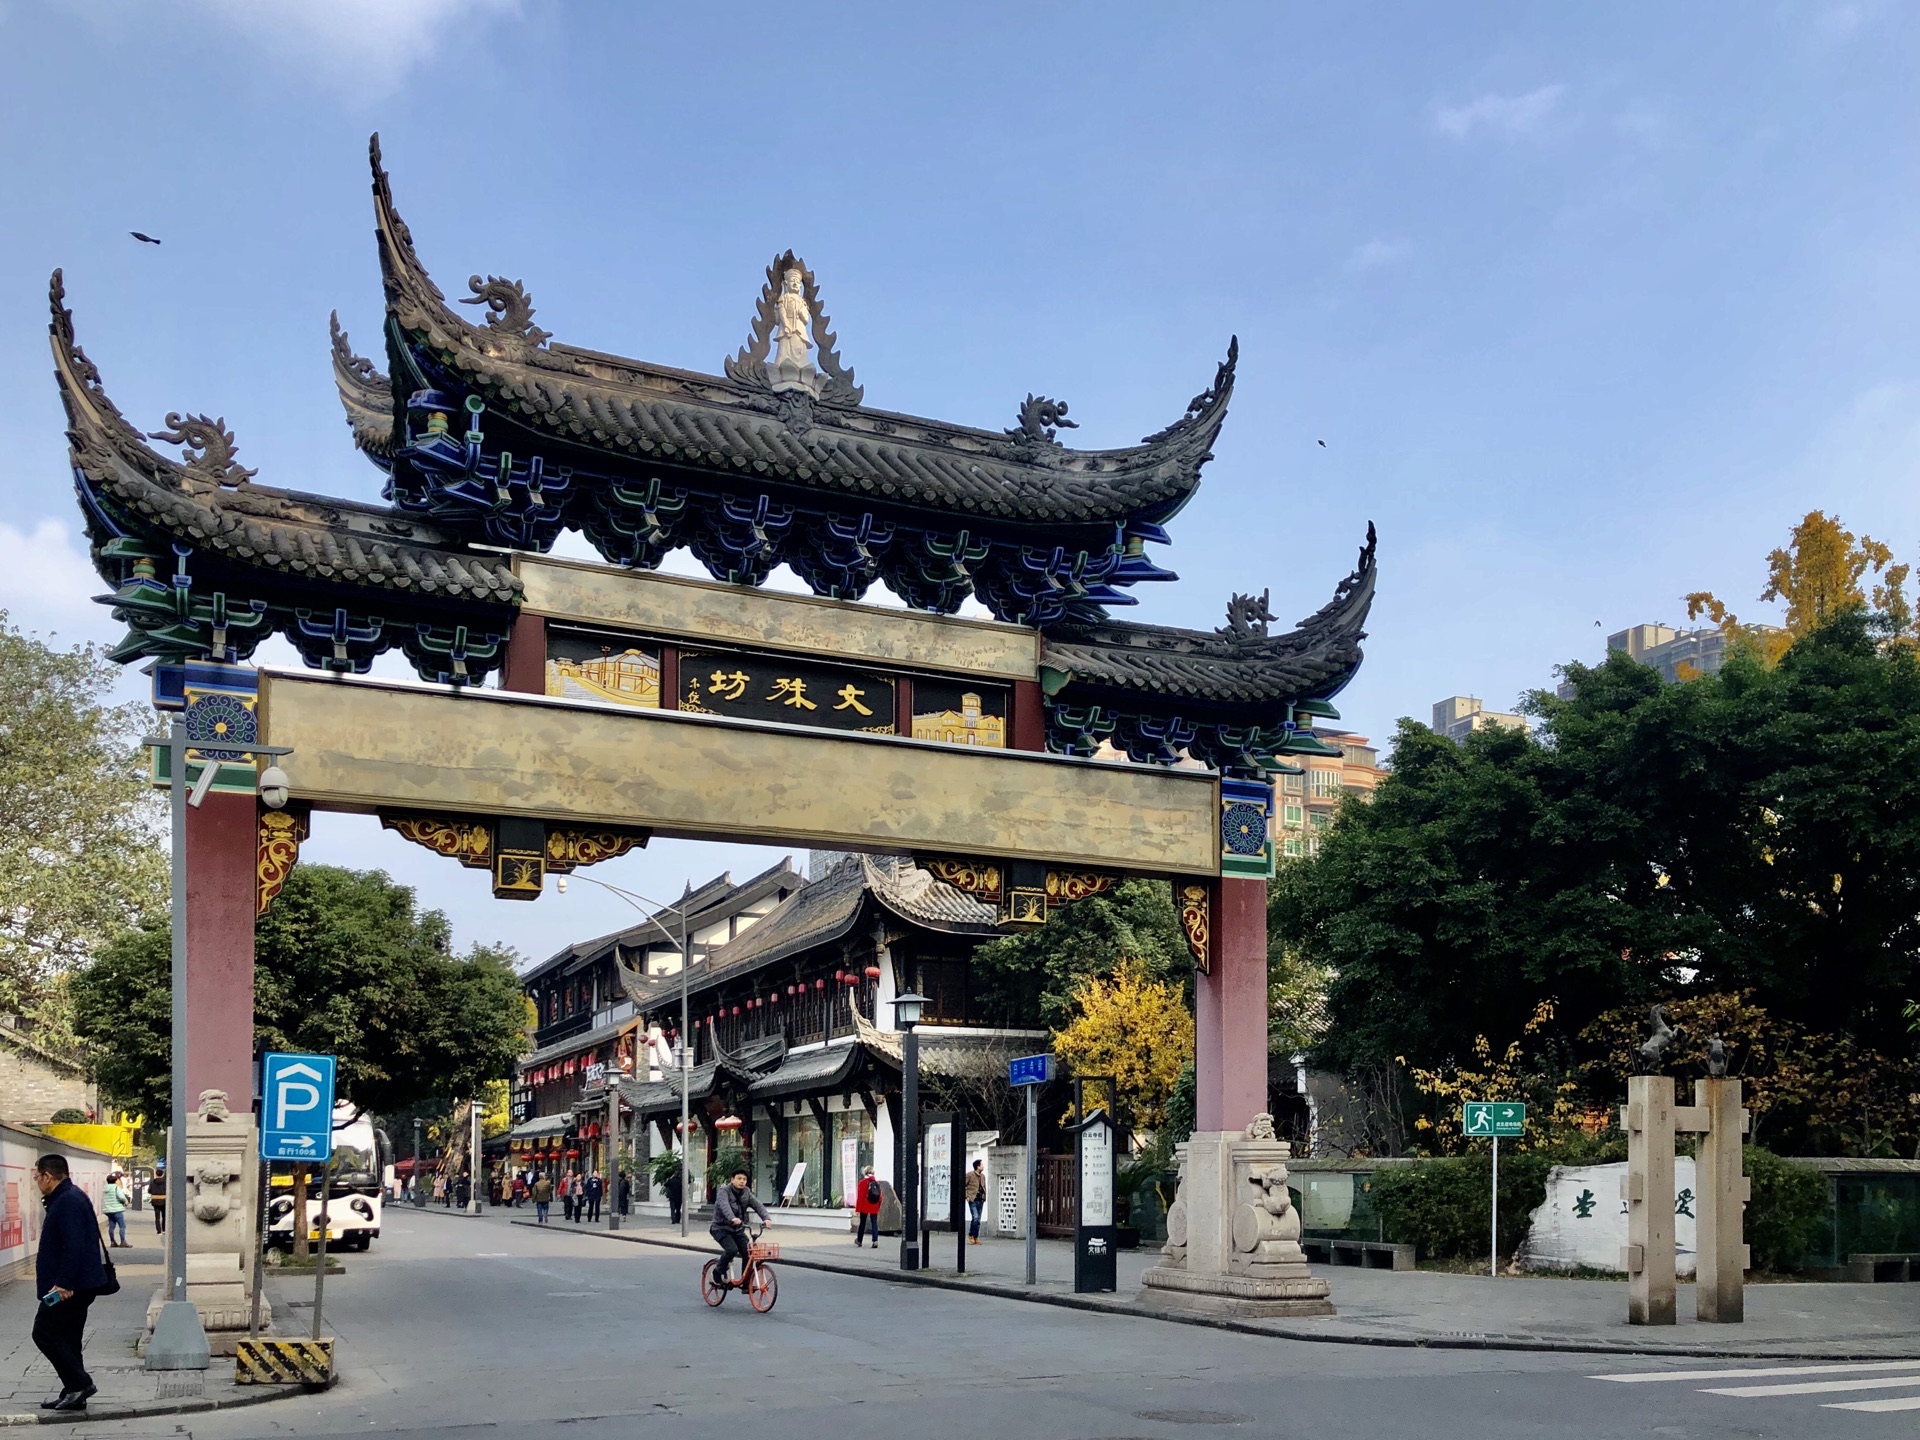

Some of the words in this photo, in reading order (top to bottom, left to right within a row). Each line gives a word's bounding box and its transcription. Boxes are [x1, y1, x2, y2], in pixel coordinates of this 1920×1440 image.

[708, 670, 874, 716] 文殊坊
[276, 1082, 320, 1129] P
[1572, 1188, 1696, 1220] 爱堂
